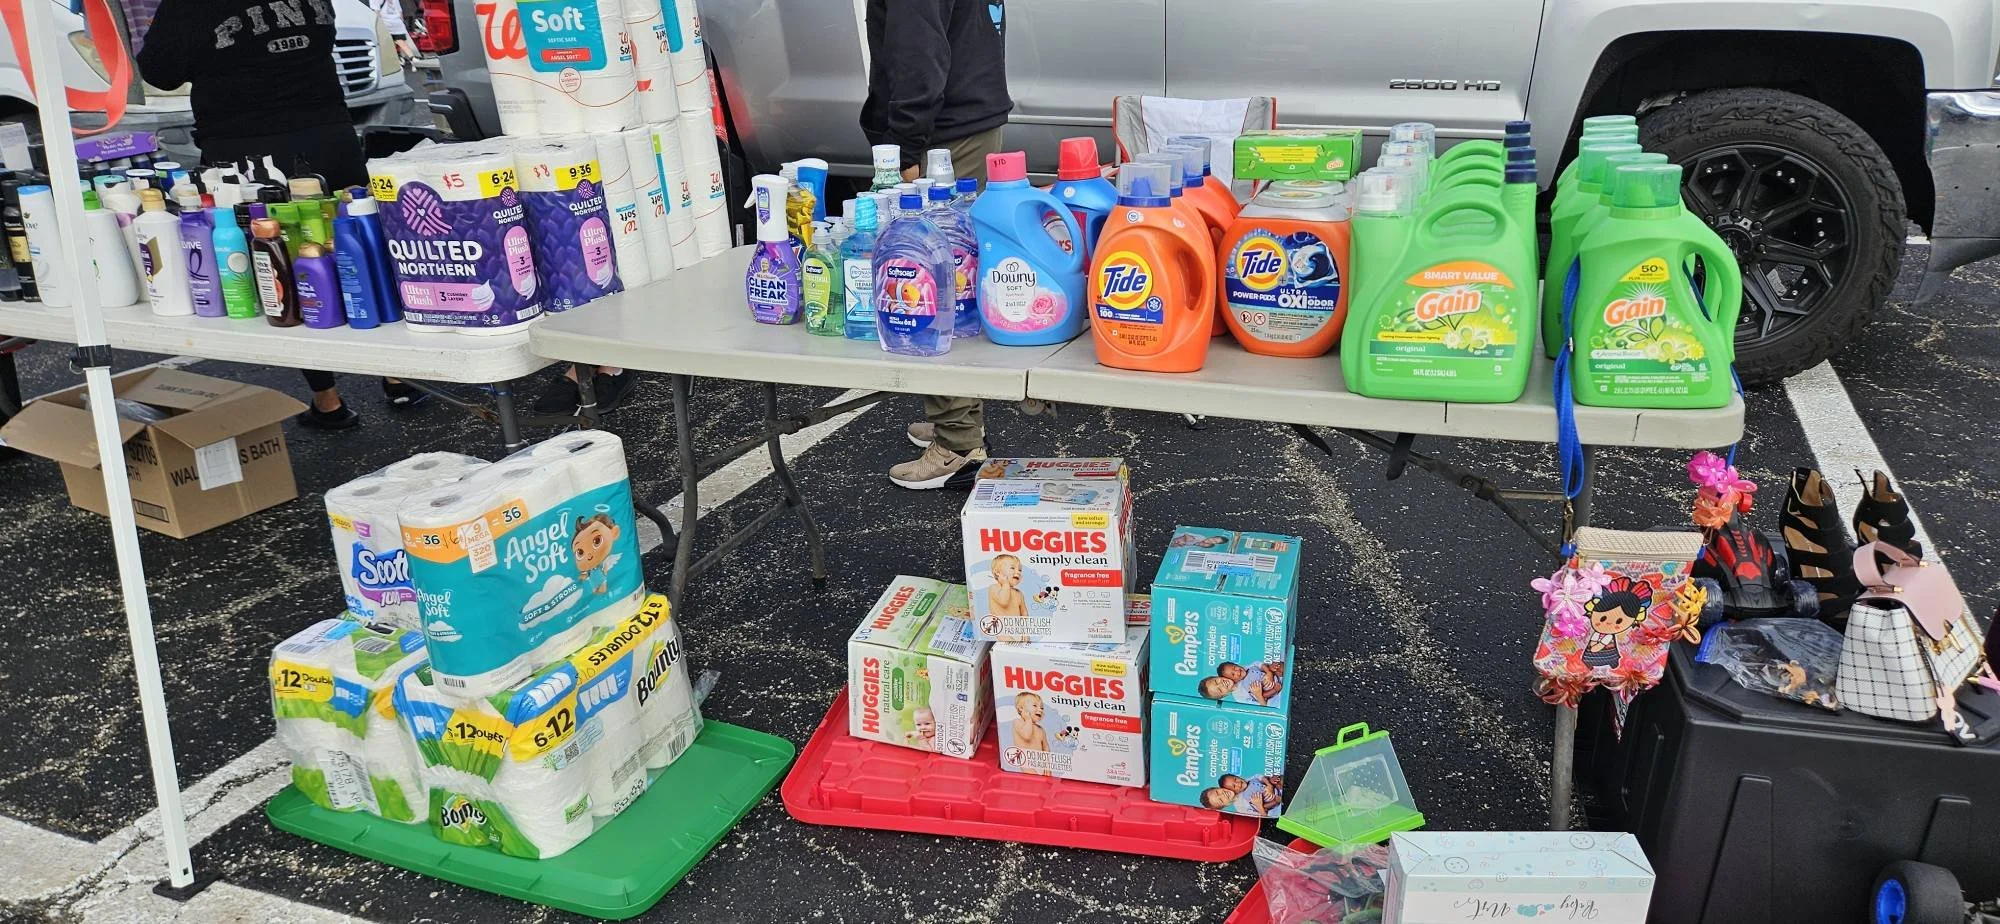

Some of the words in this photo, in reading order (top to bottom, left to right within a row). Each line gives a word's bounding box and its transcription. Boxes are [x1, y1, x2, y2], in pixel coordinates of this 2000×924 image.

[531, 6, 585, 33] Soft
[1389, 79, 1458, 90] 2500
[1463, 79, 1501, 91] HD
[442, 172, 465, 190] $5
[569, 196, 602, 212] QUILTED
[619, 208, 637, 221] Soft
[583, 227, 604, 239] Ultra
[584, 234, 607, 247] Plush
[507, 236, 528, 247] Ultra
[389, 239, 482, 261] QUILTED
[508, 245, 529, 257] Plush
[595, 247, 602, 256] 3
[519, 257, 526, 265] 3
[1241, 249, 1282, 279] Tide
[399, 262, 477, 277] NORTHERN
[888, 268, 915, 278] Softsoap
[1424, 271, 1461, 280] SMART
[1463, 271, 1498, 281] VALUE
[749, 277, 786, 290] CLEAN
[992, 271, 1035, 287] Downy
[1104, 265, 1148, 298] Tide
[404, 284, 430, 296] Ultra
[439, 292, 447, 301] 3
[749, 287, 786, 301] FREAK
[1233, 291, 1258, 299] POWER
[1280, 288, 1308, 296] ULTRA
[407, 294, 432, 306] Plush
[1278, 294, 1308, 309] OXI
[1415, 289, 1482, 321] Gain
[1604, 296, 1667, 327] Gain
[1395, 345, 1426, 355] original
[249, 437, 282, 461] BATH
[1027, 461, 1112, 469] HUGGIES
[502, 507, 522, 525] 36
[473, 522, 482, 534] 9
[423, 534, 441, 545] 36
[468, 532, 490, 544] MEGA
[503, 511, 569, 570] Angel
[980, 528, 1107, 554] HUGGIES
[473, 544, 492, 557] 320
[524, 541, 568, 584] Soft
[1030, 555, 1073, 569] simply
[1074, 554, 1108, 566] clean
[1064, 572, 1096, 580] fragrance
[1096, 571, 1110, 579] free
[416, 588, 451, 606] Angel
[524, 607, 543, 622] SOFT
[550, 584, 577, 606] STRONG
[425, 603, 450, 618] Soft
[870, 586, 915, 631] HUGGIES
[901, 598, 919, 619] natural
[1003, 617, 1014, 627] DO
[1014, 617, 1028, 627] NOT
[1029, 617, 1051, 628] FLUSH
[1241, 621, 1250, 635] 432
[1266, 624, 1274, 641] FLUSH
[588, 624, 642, 667] DOUBLES
[1174, 610, 1202, 676] Pampers
[1206, 624, 1218, 666] complete
[1217, 635, 1227, 660] clean
[1264, 641, 1273, 654] NOT
[1273, 642, 1281, 653] PAS
[1264, 654, 1273, 664] DO
[1273, 653, 1281, 663] NE
[637, 635, 682, 707] Bounty
[882, 659, 890, 679] care
[281, 669, 301, 688] 12
[1004, 665, 1125, 700] HUGGIES
[861, 656, 881, 734] HUGGIES
[881, 681, 891, 714] natural
[1051, 694, 1091, 709] simply
[1093, 699, 1126, 712] clean
[1084, 714, 1114, 724] fragrance
[1114, 717, 1128, 725] free
[456, 722, 477, 739] 12
[1243, 735, 1251, 749] 432
[1266, 738, 1274, 755] FLUSH
[1274, 740, 1282, 755] JETER
[1026, 750, 1035, 759] DO
[1037, 751, 1049, 761] NOT
[1051, 753, 1072, 765] FLUSH
[1176, 724, 1204, 786] Pampers
[1209, 738, 1221, 778] complete
[1219, 748, 1229, 772] clean
[1265, 756, 1273, 767] NOT
[1026, 760, 1037, 768] PAS
[1048, 762, 1073, 772] TOILETTES
[1264, 768, 1273, 777] DO
[1273, 767, 1281, 776] NE
